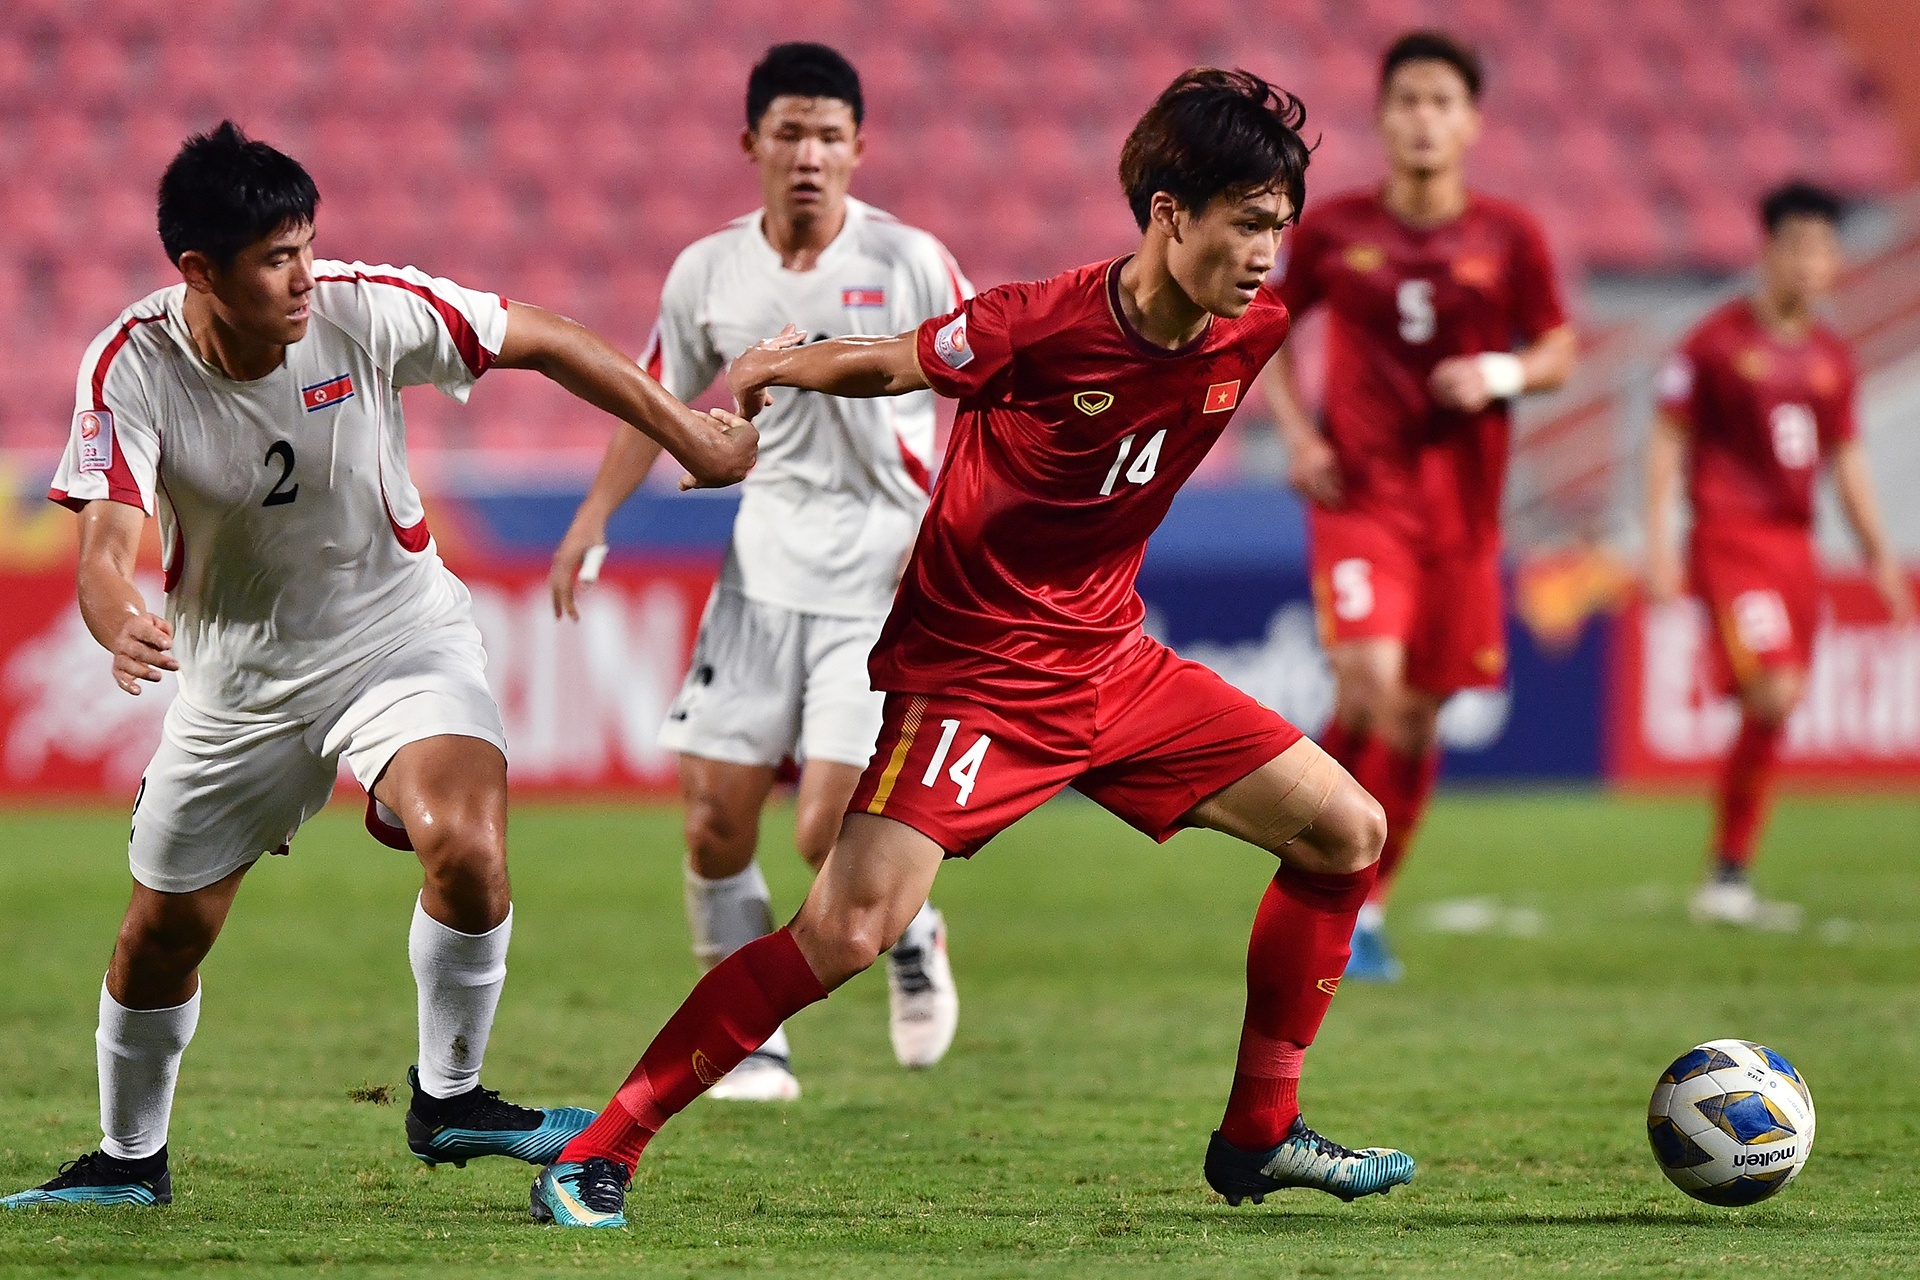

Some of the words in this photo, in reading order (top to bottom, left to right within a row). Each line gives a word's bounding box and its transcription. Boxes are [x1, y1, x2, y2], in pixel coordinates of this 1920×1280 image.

[1396, 279, 1435, 344] 5
[262, 440, 299, 507] 2
[1100, 429, 1167, 496] 14
[1332, 557, 1374, 621] 5
[921, 719, 991, 807] 14
[1747, 1071, 1762, 1083] FIFA
[1734, 1145, 1796, 1166] molten
